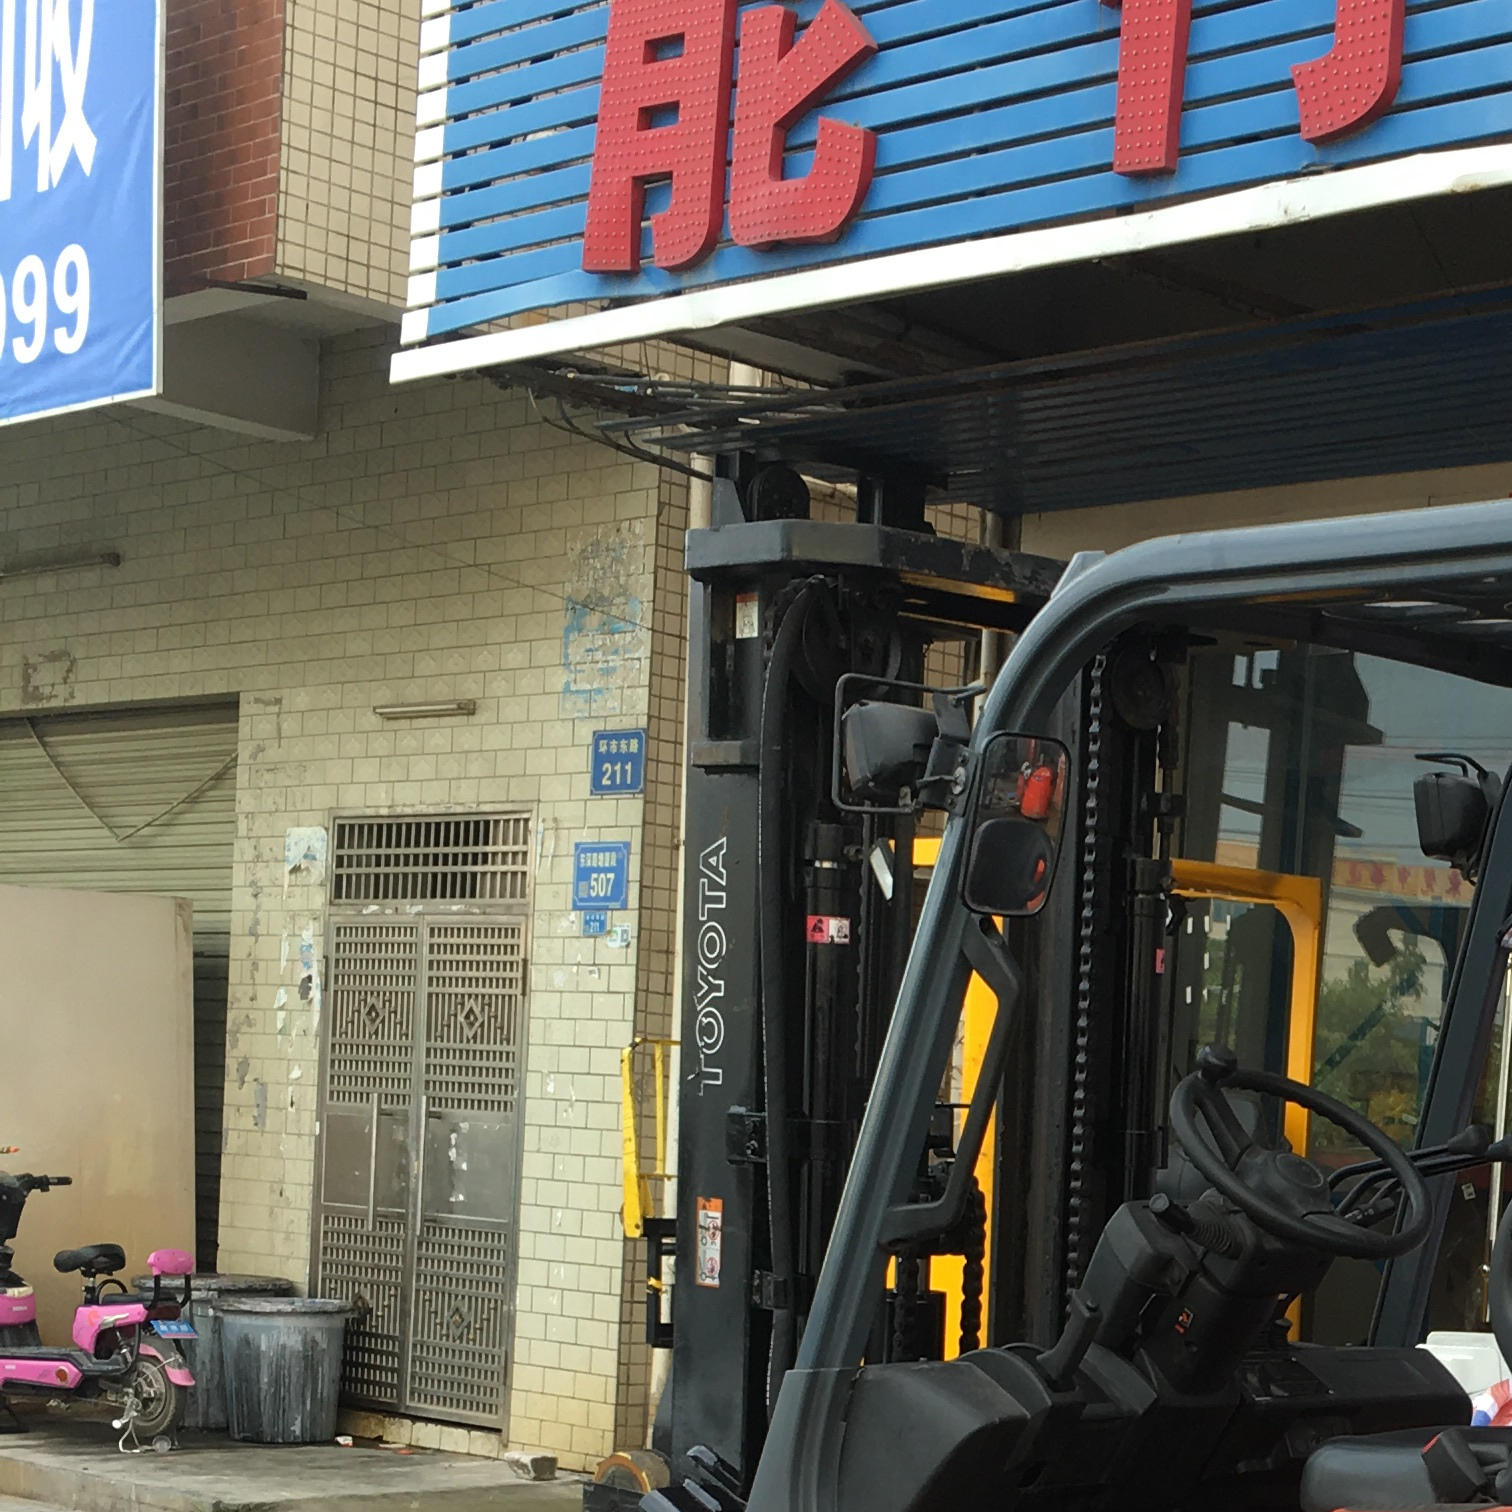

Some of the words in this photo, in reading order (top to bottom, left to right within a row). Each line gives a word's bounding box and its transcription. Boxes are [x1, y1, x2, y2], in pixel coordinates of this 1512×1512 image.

[0, 243, 91, 364] 99
[601, 761, 632, 786] 211
[590, 872, 615, 898] 507
[695, 837, 728, 1098] TOYOTA
